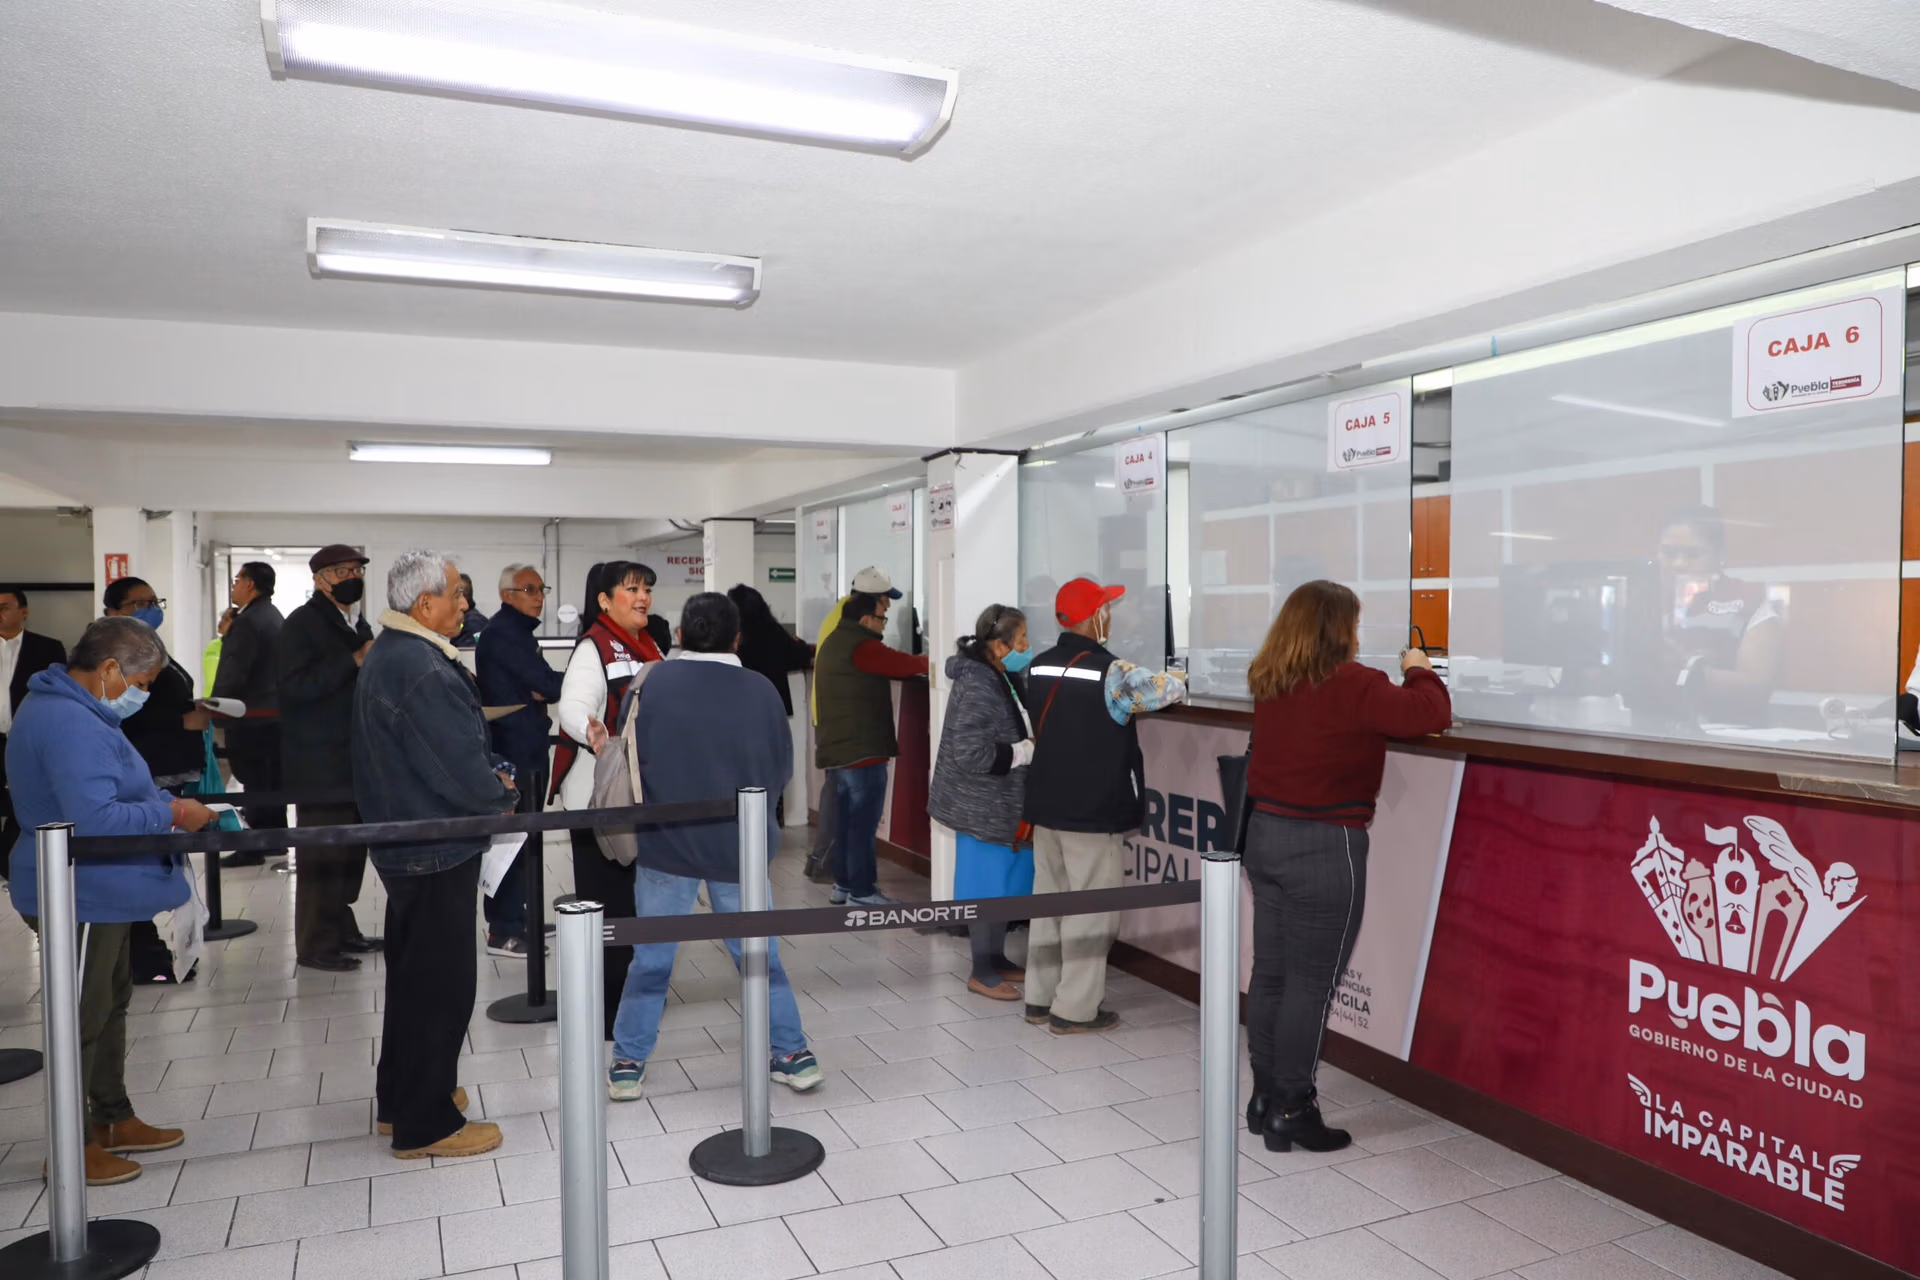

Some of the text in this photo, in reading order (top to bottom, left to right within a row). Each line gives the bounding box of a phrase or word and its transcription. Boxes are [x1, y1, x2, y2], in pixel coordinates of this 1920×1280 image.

[1767, 326, 1860, 357] CAJA 6
[1791, 381, 1829, 394] Puebla
[1345, 412, 1390, 431] CAJA 5
[1125, 451, 1153, 465] CAJA 4
[869, 904, 978, 926] BANORTE
[1628, 958, 1866, 1081] Puebla
[1628, 1024, 1864, 1110] GOBIERNO DE LA CIUDAD
[1655, 1093, 1825, 1171] LA CAPITAL
[1644, 1108, 1845, 1212] IMPARABLE
